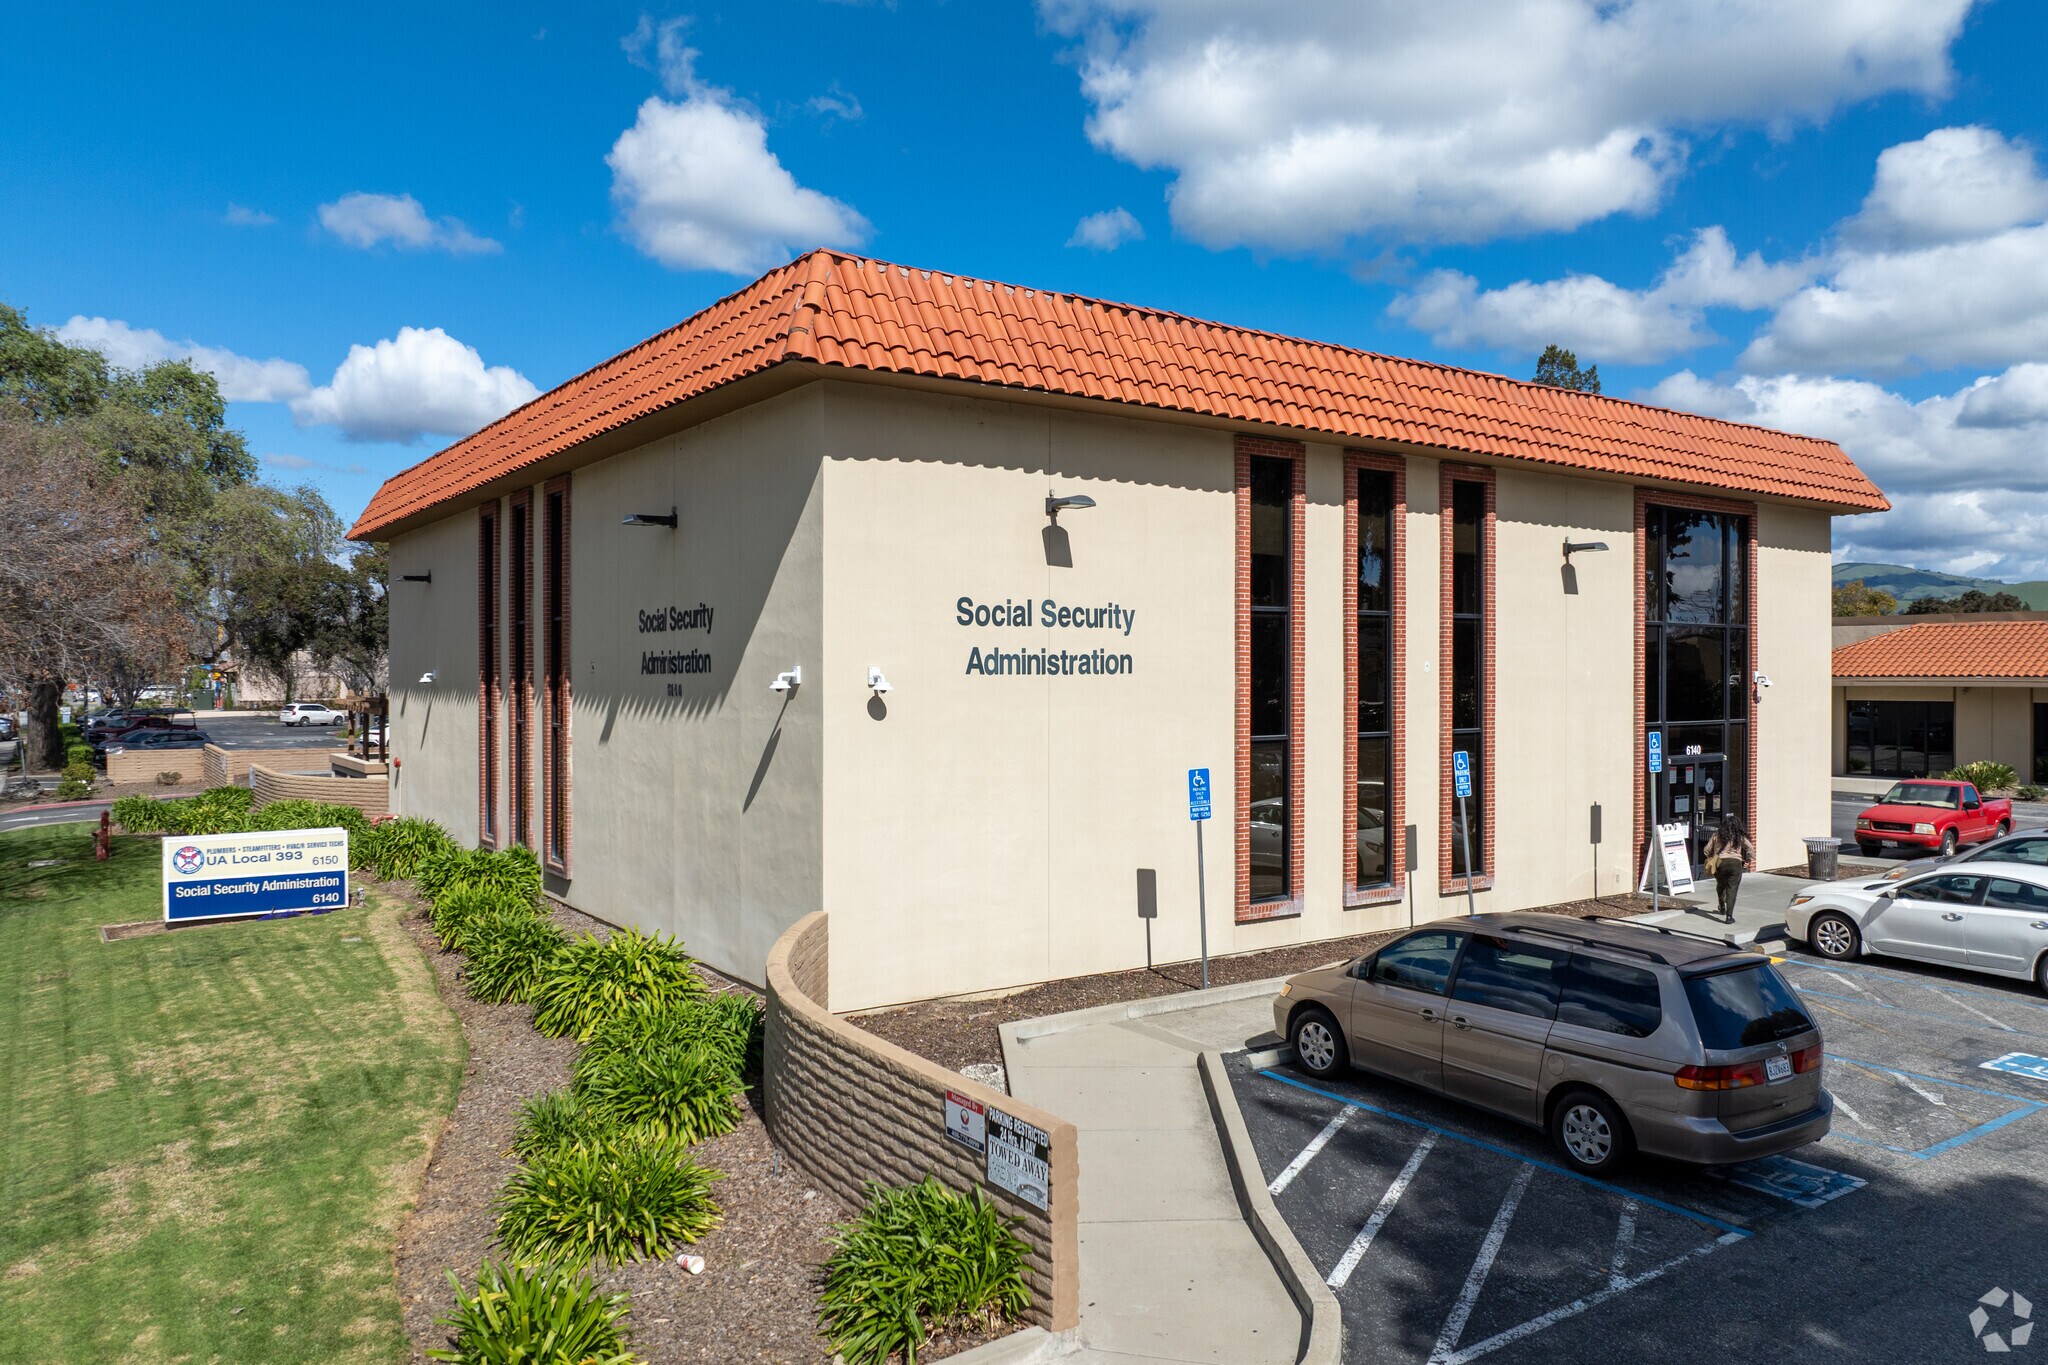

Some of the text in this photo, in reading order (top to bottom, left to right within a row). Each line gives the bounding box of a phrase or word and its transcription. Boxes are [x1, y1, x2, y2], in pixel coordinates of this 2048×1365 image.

[639, 603, 714, 634] Social Security
[957, 597, 1136, 636] Social Security
[641, 648, 711, 675] Administration
[965, 646, 1133, 675] Administration
[1686, 745, 1702, 756] 6140
[206, 847, 236, 855] PLUMBERS
[242, 844, 281, 852] STEAMFITTERS
[206, 851, 303, 866] UA Local 393
[312, 855, 339, 865] 6150
[176, 876, 340, 898] Social Security Administration
[312, 893, 340, 904] 6140
[951, 1092, 979, 1112] Managed By
[989, 1107, 1048, 1148] PARKING RESTRICTED
[999, 1127, 1007, 1141] 24
[1019, 1137, 1025, 1152] A
[1025, 1139, 1037, 1157] DAY
[990, 1141, 1047, 1182] TOWED AWAY
